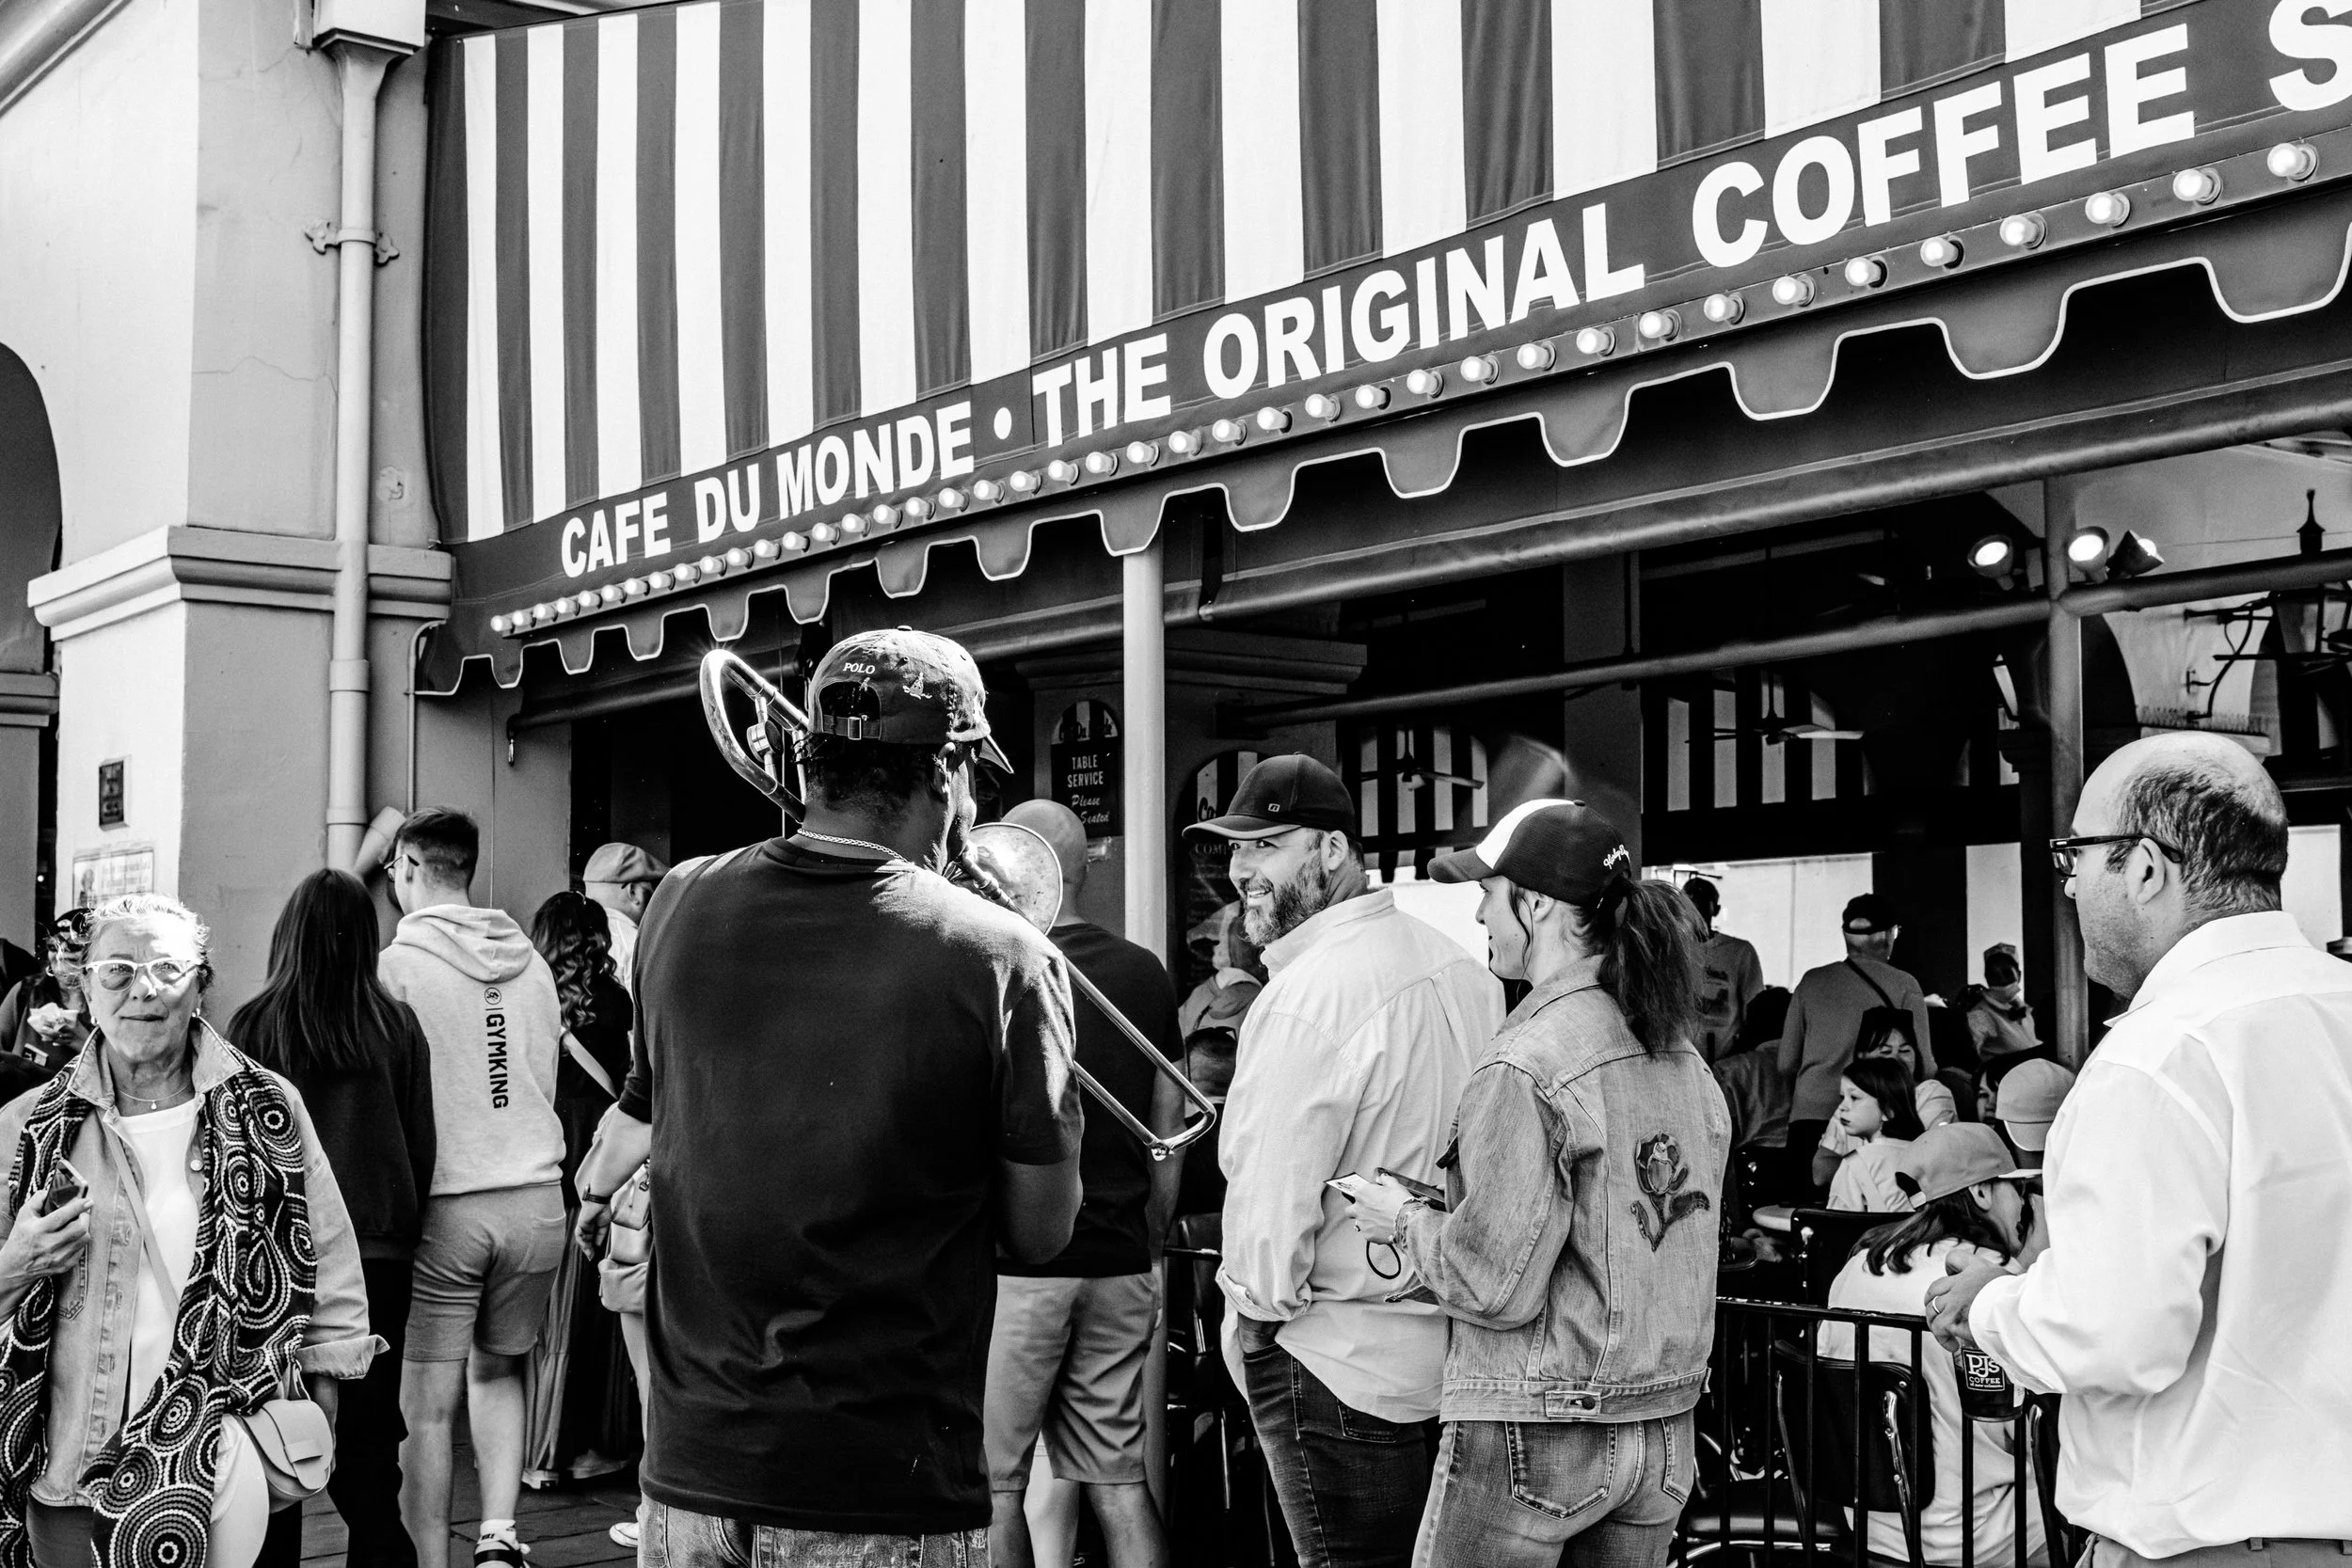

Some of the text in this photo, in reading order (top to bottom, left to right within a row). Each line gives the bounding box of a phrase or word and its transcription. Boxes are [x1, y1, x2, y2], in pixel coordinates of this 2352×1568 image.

[562, 492, 671, 578] CAFE
[694, 464, 761, 544] DU
[776, 401, 975, 519] MONDE
[1032, 333, 1171, 448] THE
[1203, 203, 1645, 399] ORIGINAL
[1692, 24, 2196, 268] COFFEE
[843, 662, 876, 674] POLO
[1072, 754, 1098, 769] TABLE
[1067, 770, 1104, 788] SERVICE
[1071, 794, 1100, 808] Please
[1080, 810, 1110, 825] Seated
[485, 1013, 509, 1109] GYMKING
[1968, 1375, 2001, 1385] COFFEE
